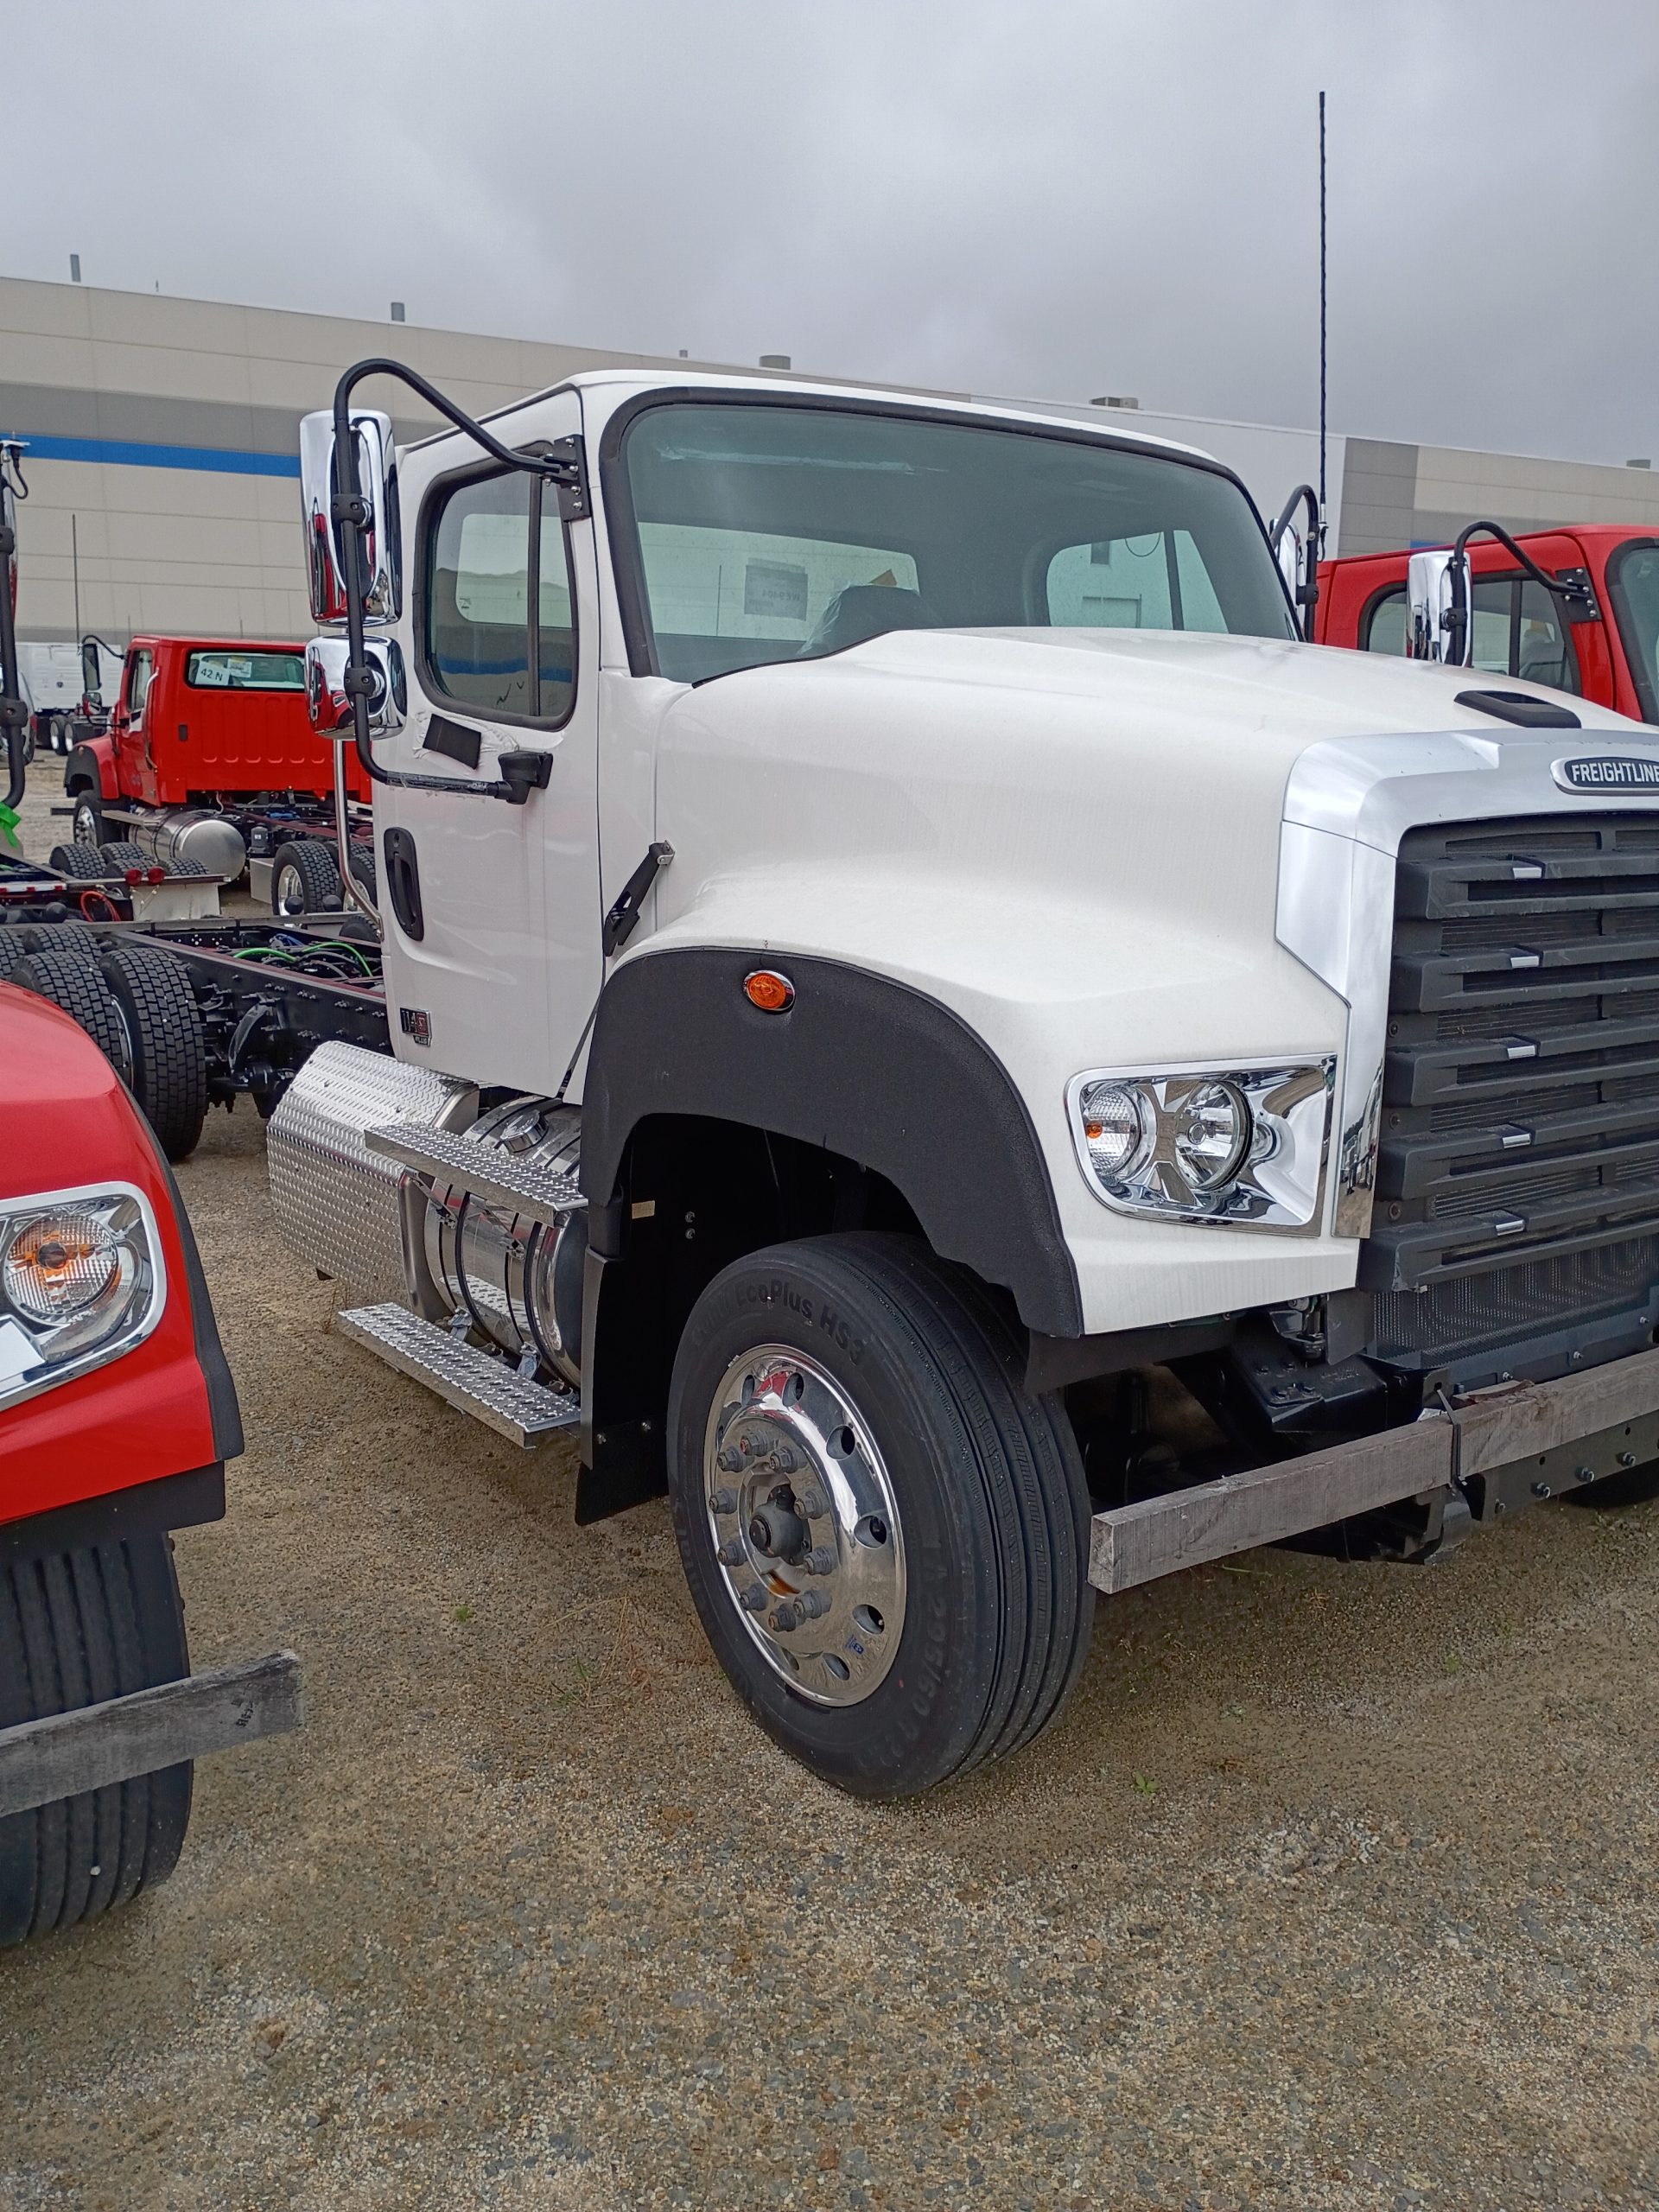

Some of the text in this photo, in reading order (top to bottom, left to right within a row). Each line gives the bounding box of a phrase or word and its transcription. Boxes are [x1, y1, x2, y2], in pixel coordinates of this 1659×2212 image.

[200, 668, 223, 681] 42 N
[734, 1278, 813, 1319] EcoPlus
[820, 1303, 865, 1366] HS3
